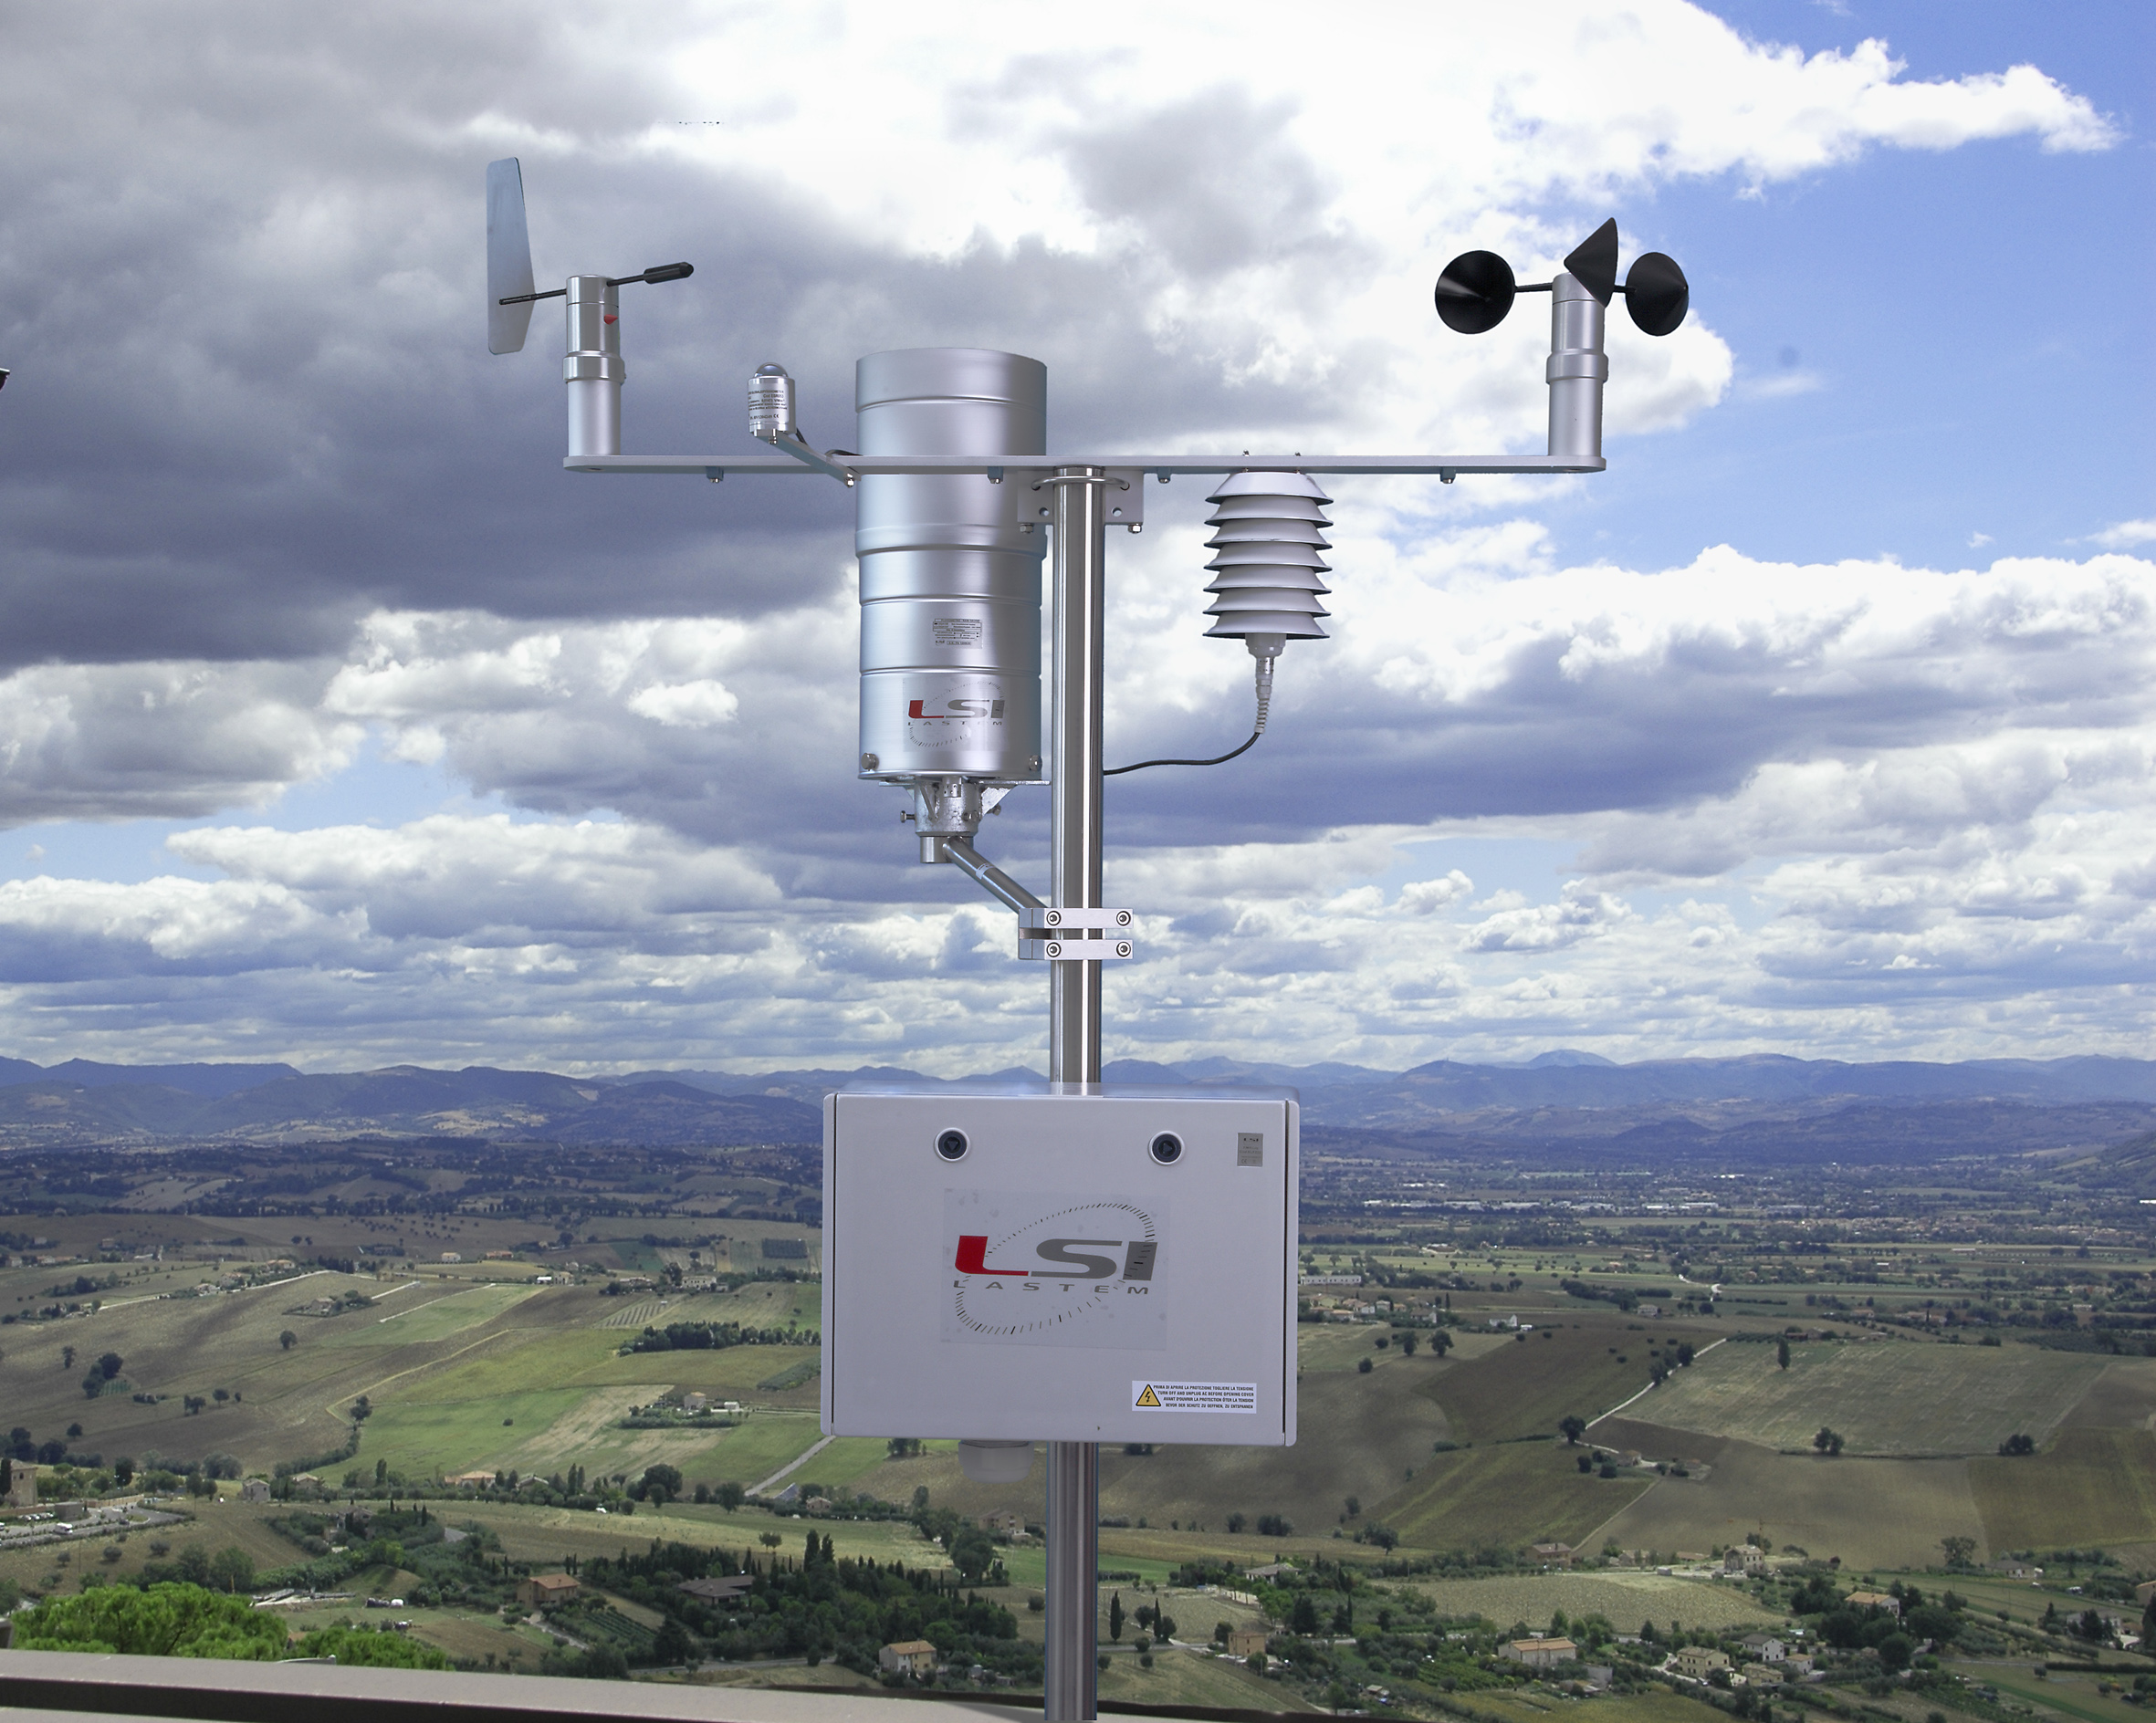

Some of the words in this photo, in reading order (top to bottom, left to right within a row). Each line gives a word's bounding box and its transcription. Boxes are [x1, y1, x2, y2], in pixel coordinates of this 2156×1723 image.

[908, 699, 1005, 719] LSI
[954, 1235, 1158, 1281] LSI
[953, 1280, 1149, 1295] LASTEM
